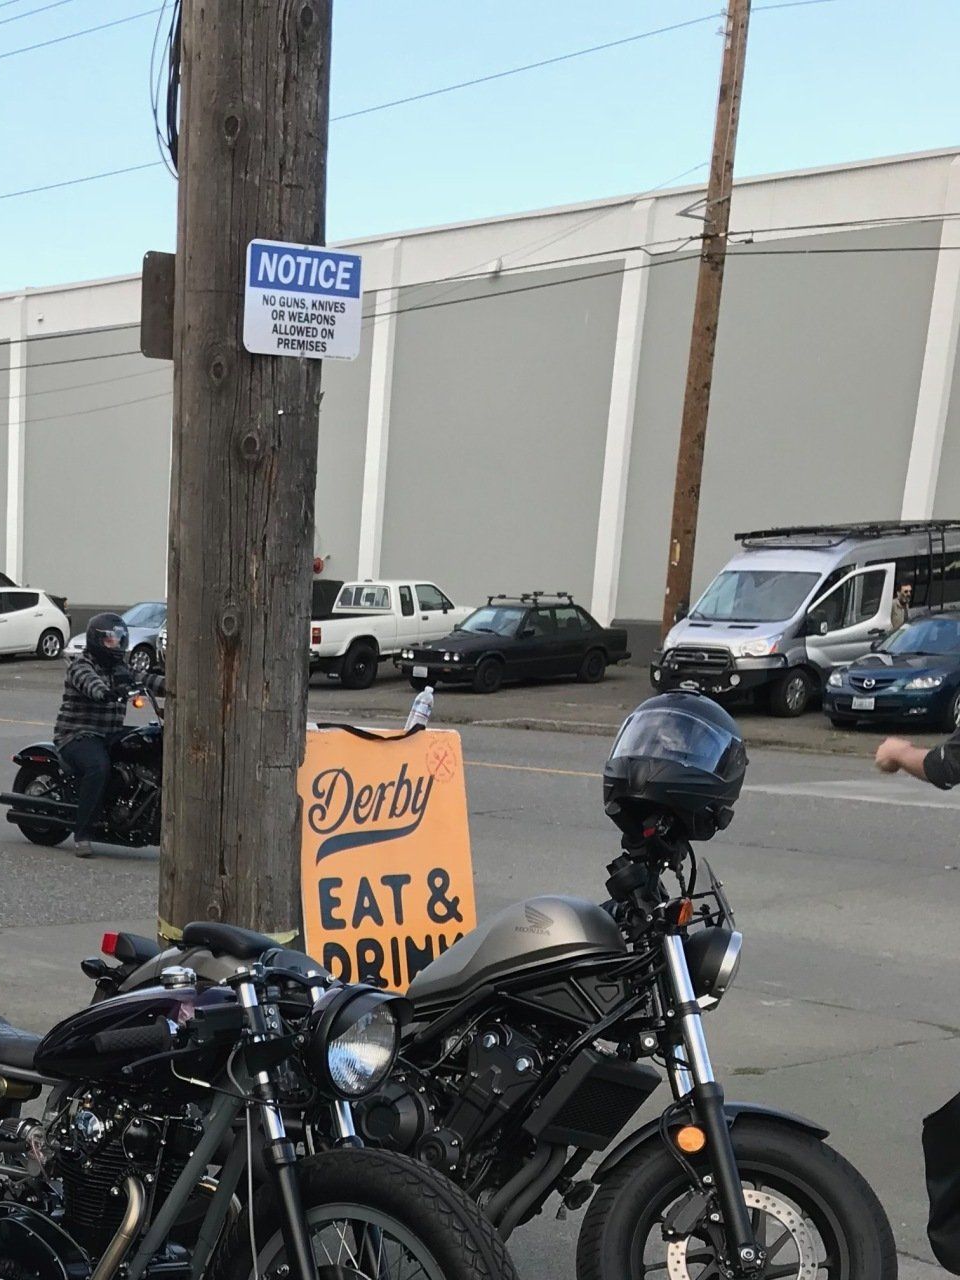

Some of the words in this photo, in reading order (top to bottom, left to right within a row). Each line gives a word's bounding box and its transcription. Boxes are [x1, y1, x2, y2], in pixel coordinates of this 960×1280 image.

[258, 251, 354, 291] NOTICE
[262, 294, 276, 306] NO
[279, 296, 309, 311] GUNS,
[311, 299, 346, 314] KNIVES
[271, 309, 285, 321] OR
[288, 311, 336, 326] WEAPONS
[272, 323, 318, 338] ALLOWED
[320, 328, 335, 340] ON
[277, 338, 327, 353] PREMISES
[308, 763, 435, 836] Derby
[318, 873, 412, 930] EAT
[427, 867, 464, 924] &
